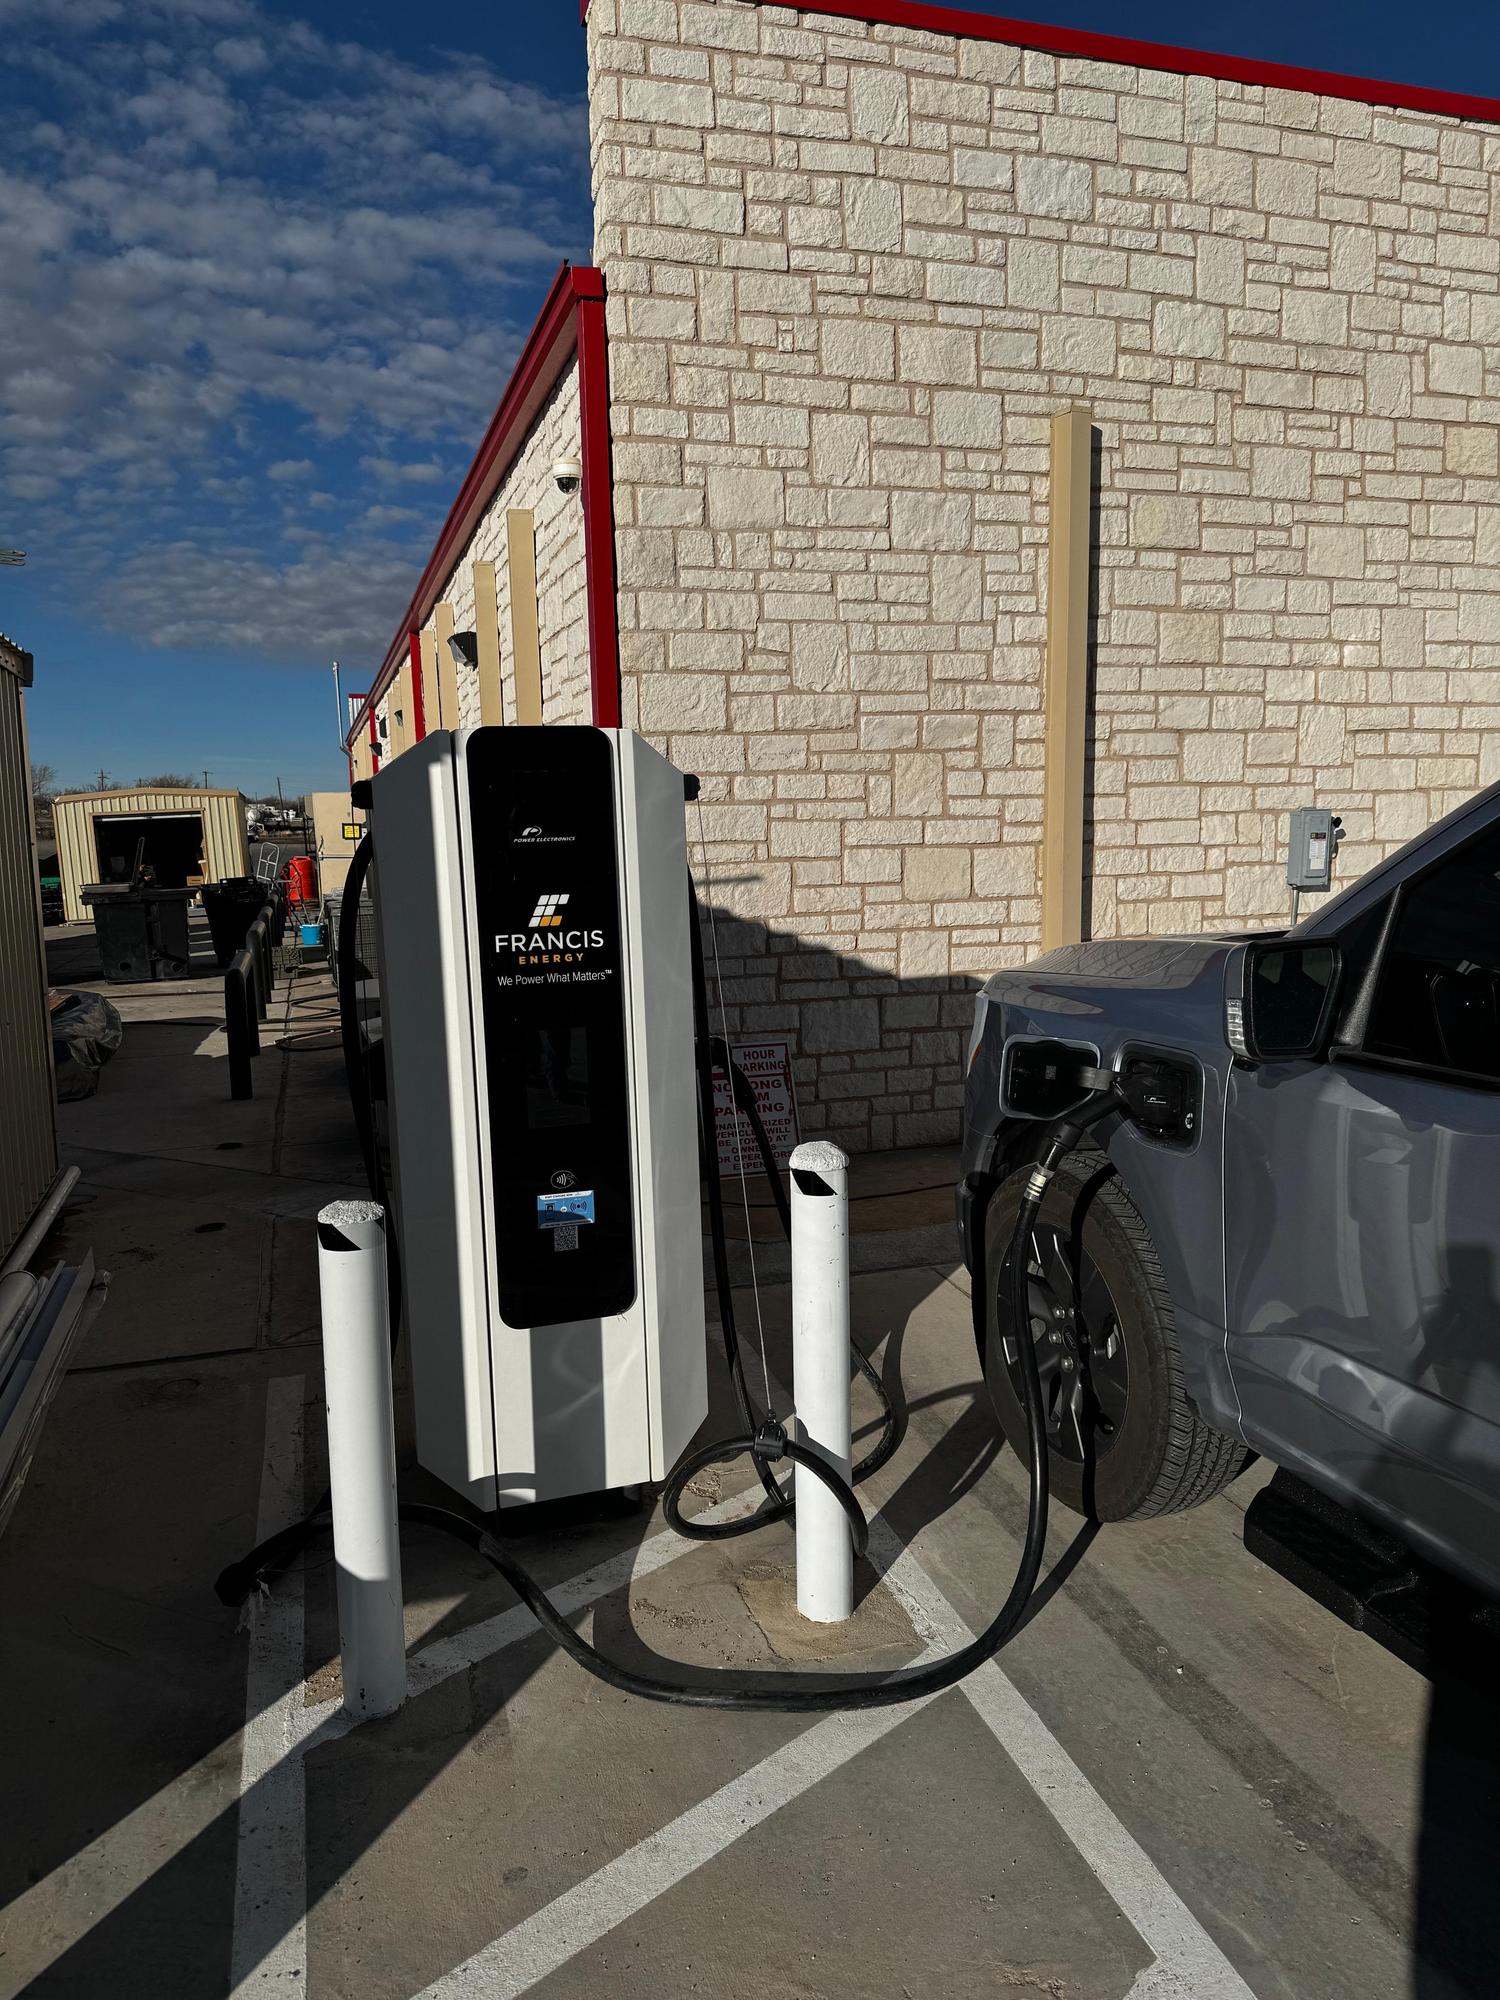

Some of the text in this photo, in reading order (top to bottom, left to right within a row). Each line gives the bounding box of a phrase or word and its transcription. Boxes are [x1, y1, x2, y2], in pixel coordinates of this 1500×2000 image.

[495, 930, 604, 953] FRANCIS
[519, 953, 584, 965] ENERGY
[497, 975, 513, 986] We
[515, 973, 544, 985] Power
[547, 972, 570, 983] What
[743, 1049, 776, 1060] HOUR
[714, 1103, 784, 1116] PARING
[716, 1119, 791, 1130] NAUTHRIZED
[717, 1130, 756, 1138] EHICLE
[739, 1136, 772, 1145] TOWD
[731, 1144, 777, 1153] OWNES
[734, 1151, 791, 1161] OPERORS
